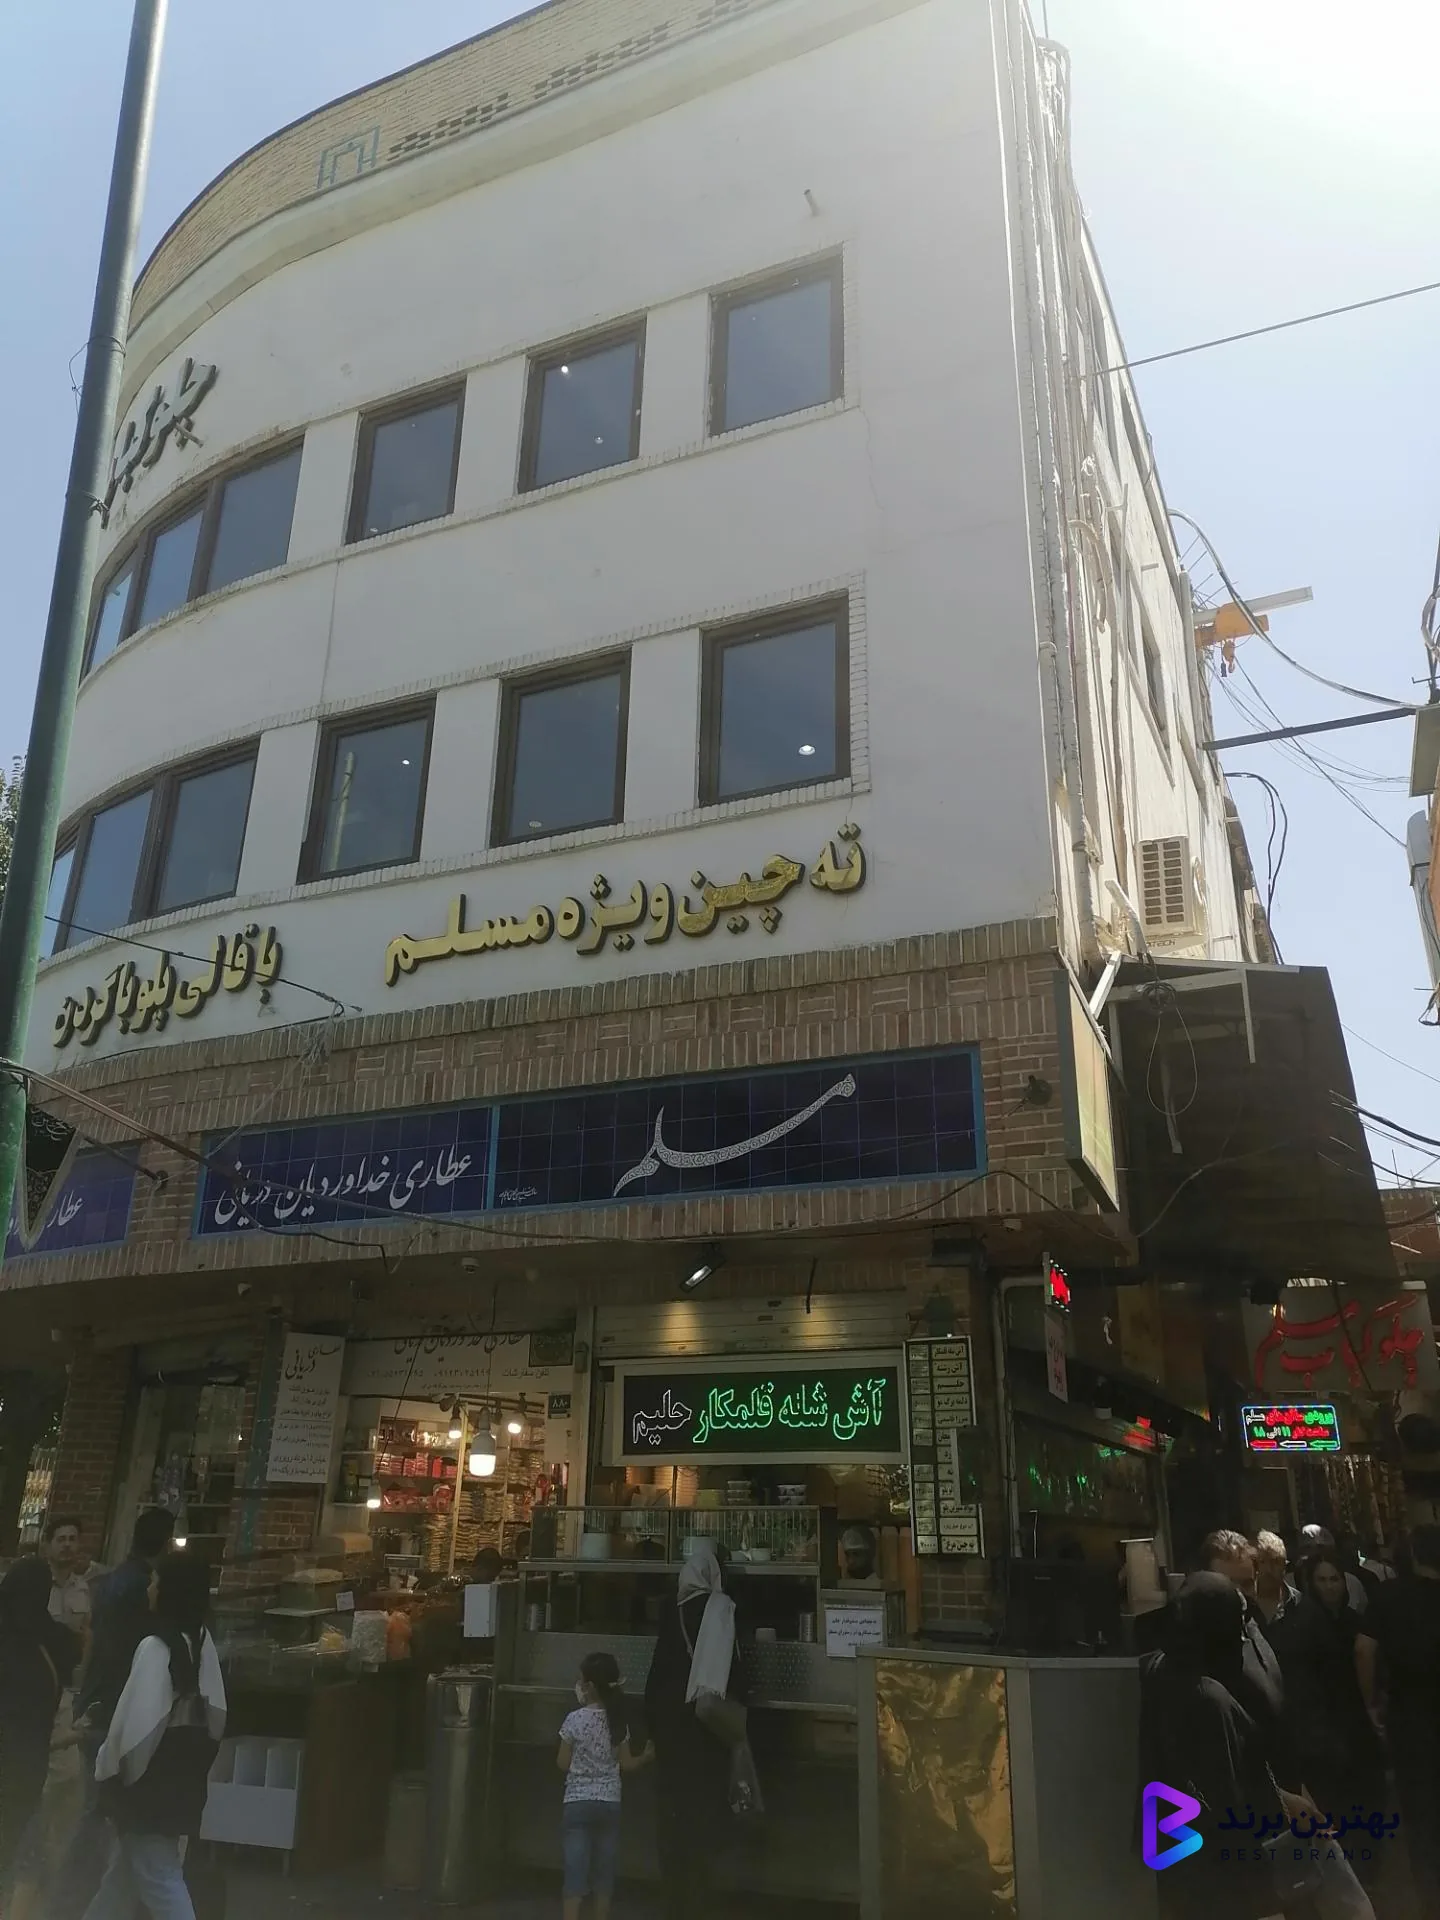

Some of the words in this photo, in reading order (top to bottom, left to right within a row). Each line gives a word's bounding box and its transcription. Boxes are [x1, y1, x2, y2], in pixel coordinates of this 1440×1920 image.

[808, 822, 866, 896] ته
[556, 872, 674, 956] ویژه
[677, 854, 806, 938] چین
[385, 894, 555, 987] مسلم
[614, 1073, 857, 1197] مسلم
[389, 1143, 472, 1210] عطاری
[632, 1389, 693, 1446] حلیم
[693, 1382, 774, 1443] قلمکار
[778, 1382, 829, 1428] شله
[833, 1379, 886, 1440] آش
